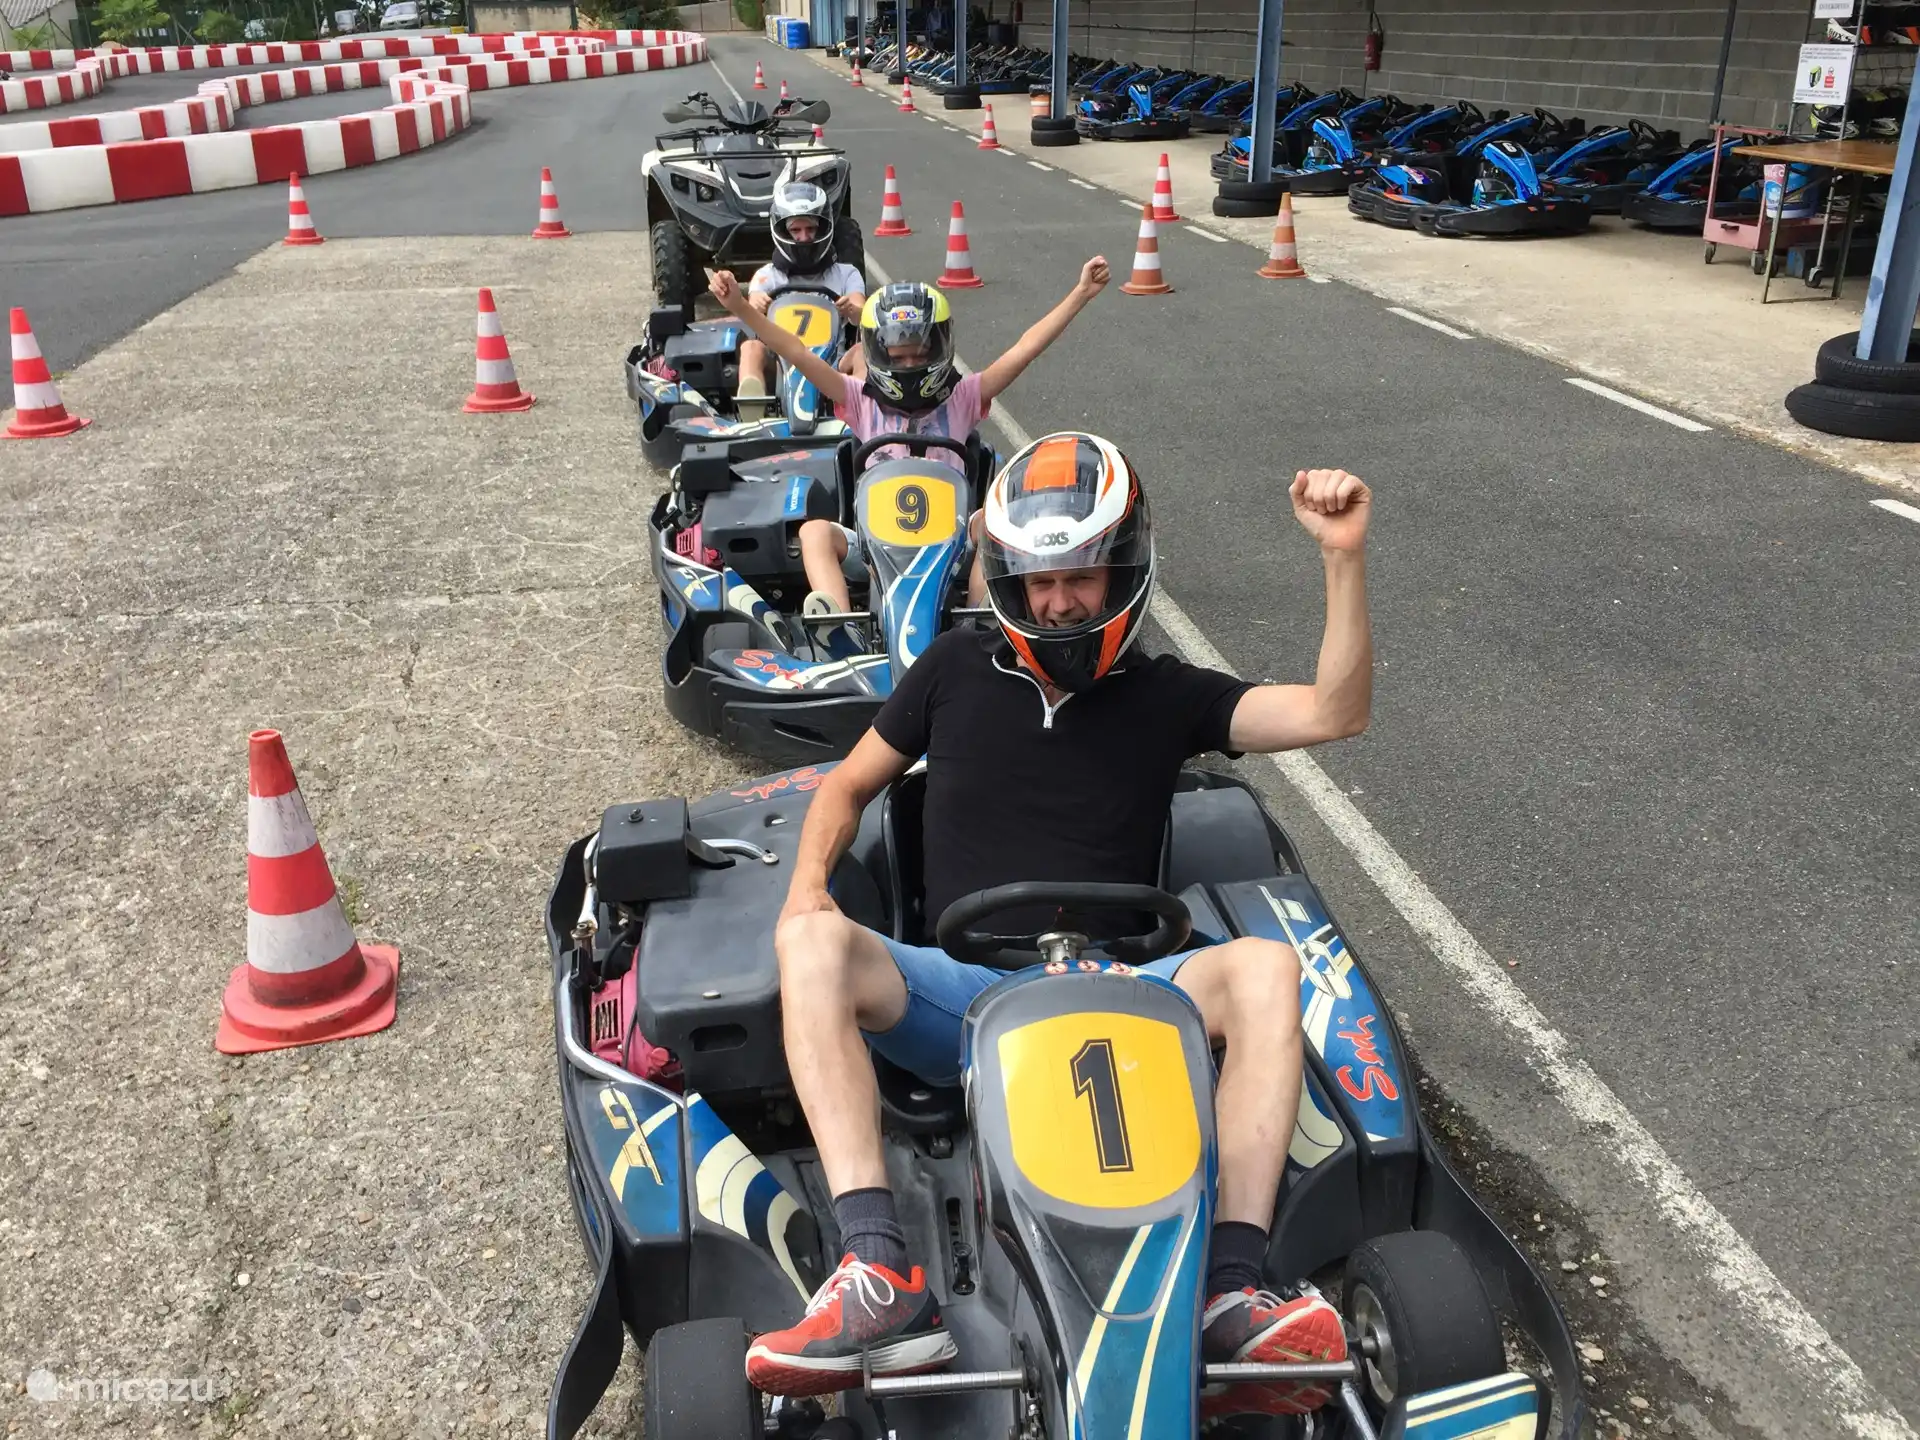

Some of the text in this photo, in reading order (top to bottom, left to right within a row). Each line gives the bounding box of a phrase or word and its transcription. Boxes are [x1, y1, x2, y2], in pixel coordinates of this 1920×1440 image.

[1503, 143, 1517, 152] 6
[793, 309, 813, 336] 7
[895, 484, 930, 532] 9
[1335, 1014, 1399, 1102] Sodi
[1069, 1038, 1135, 1174] 1
